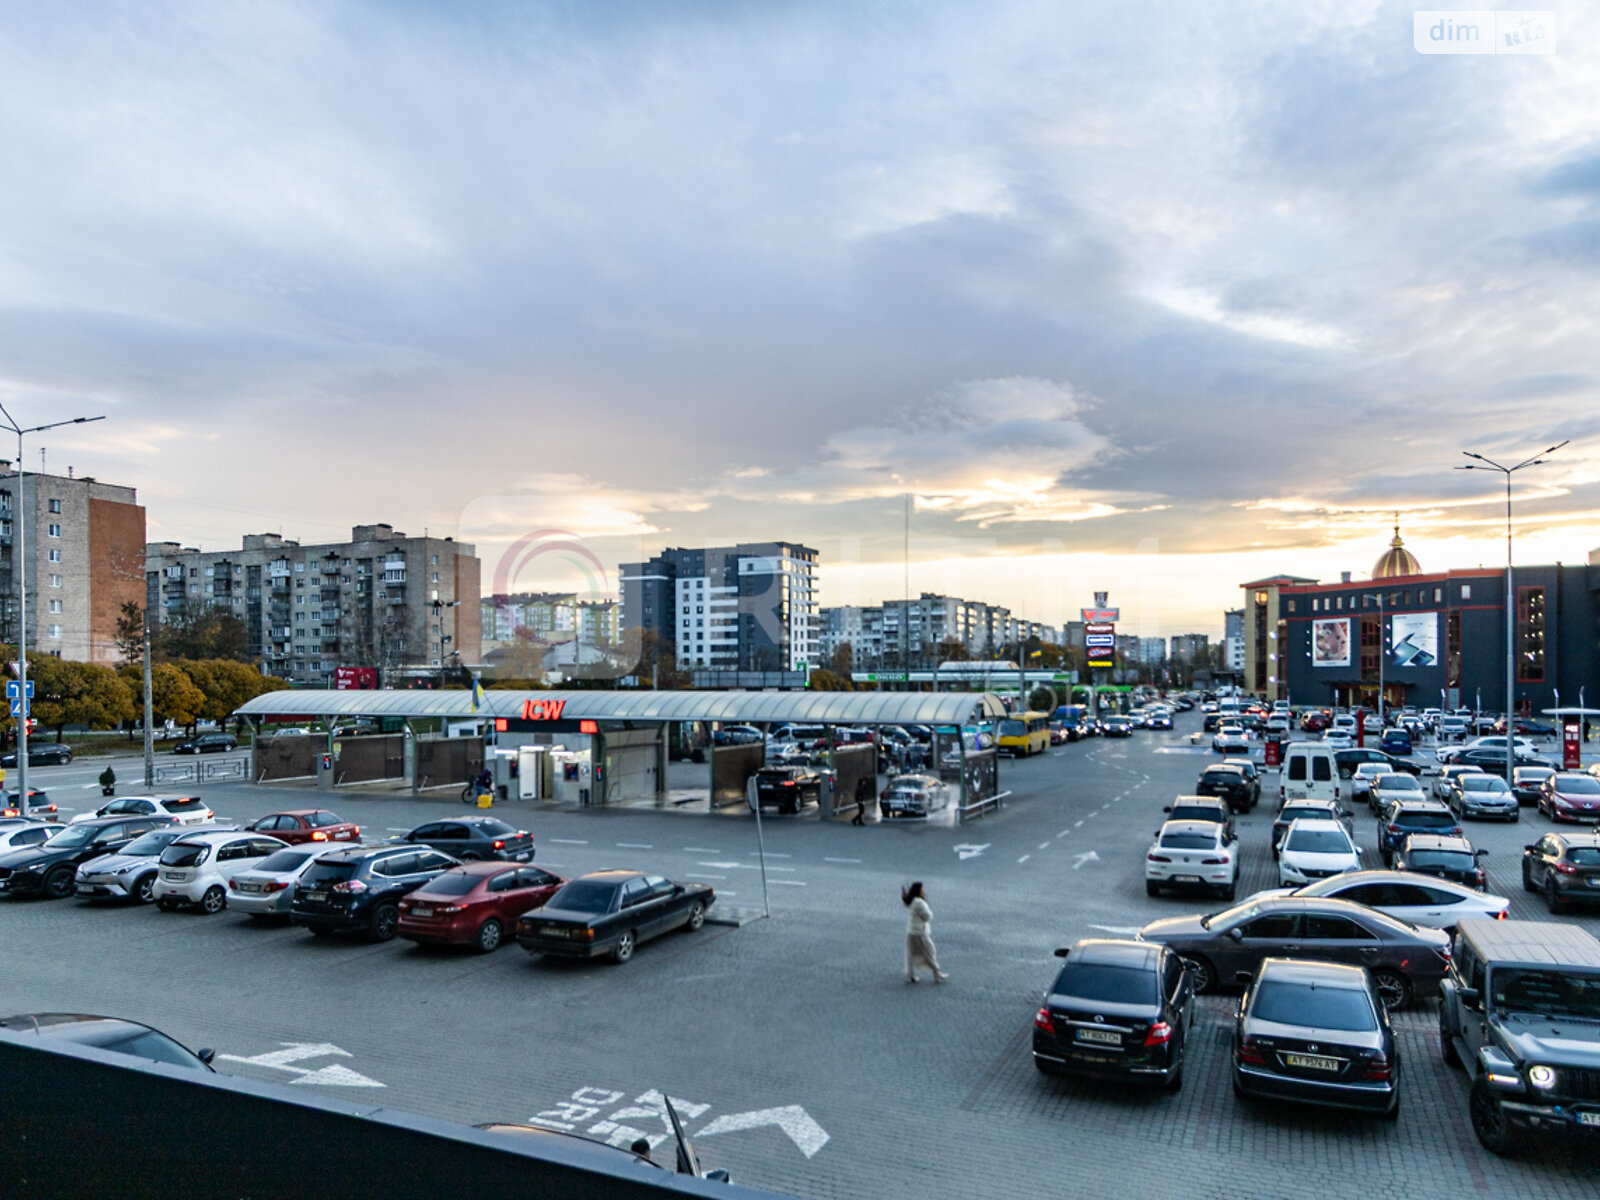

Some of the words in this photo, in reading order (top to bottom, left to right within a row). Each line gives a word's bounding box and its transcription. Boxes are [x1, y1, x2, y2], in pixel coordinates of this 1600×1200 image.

[521, 699, 566, 721] ICW
[1292, 1055, 1303, 1064] AT
[1325, 1059, 1335, 1069] AT
